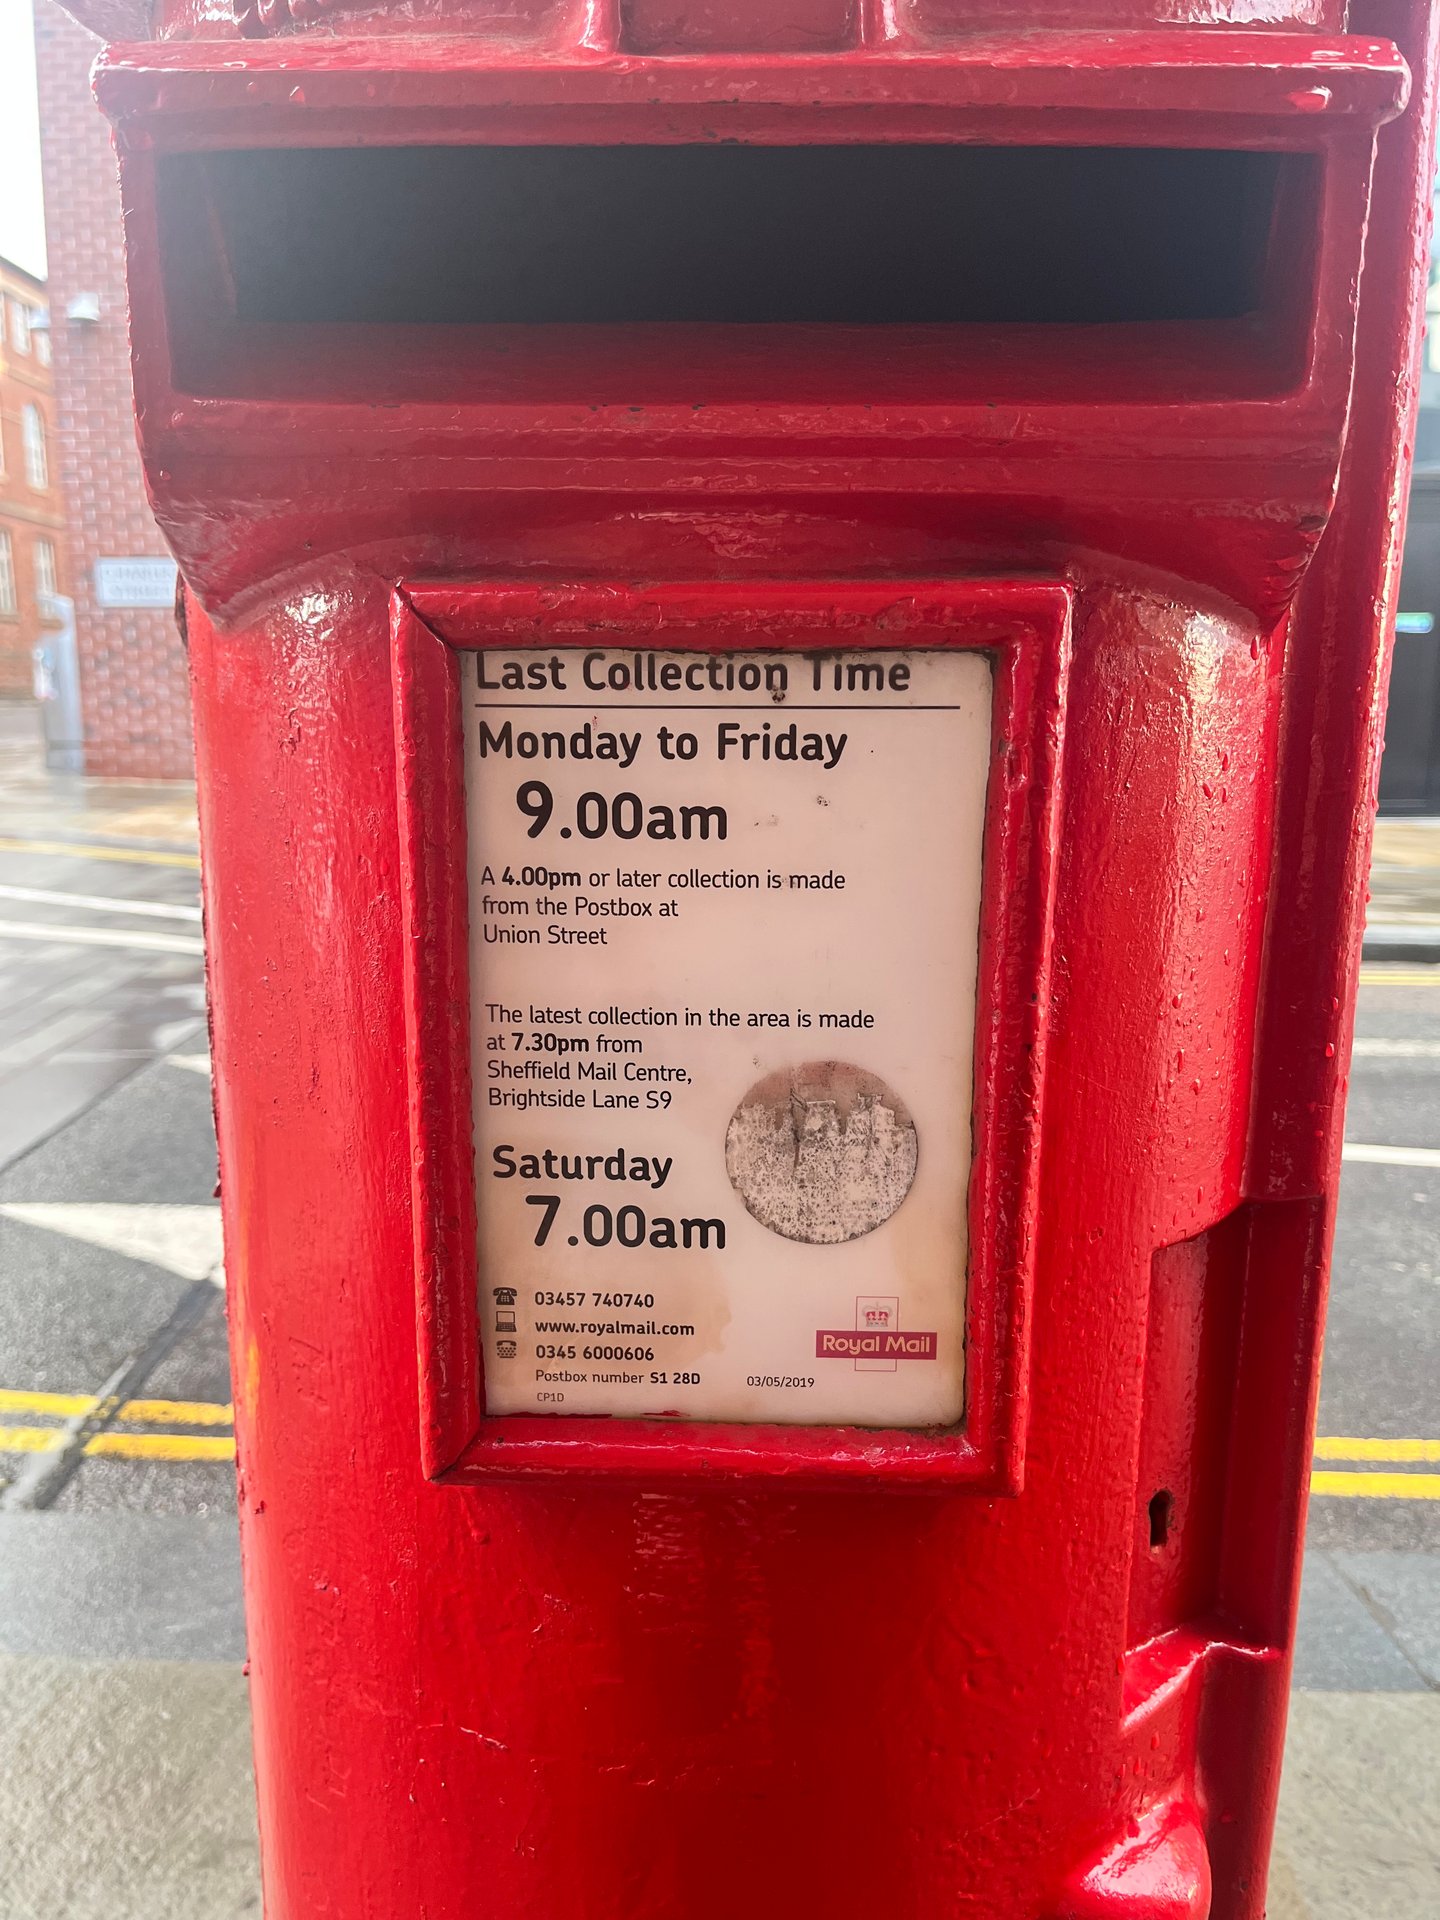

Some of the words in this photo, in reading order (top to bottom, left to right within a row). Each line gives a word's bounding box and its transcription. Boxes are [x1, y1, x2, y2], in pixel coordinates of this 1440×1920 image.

[476, 652, 566, 690] Last
[582, 653, 788, 692] Collection
[804, 655, 911, 691] Time
[479, 721, 641, 768] Monday
[657, 727, 698, 760] to
[718, 723, 847, 769] Friday
[517, 781, 727, 840] 9.00am
[481, 866, 495, 885] A
[502, 866, 581, 890] 4.00pm
[589, 873, 610, 887] or
[617, 868, 661, 887] later
[668, 869, 759, 888] collection
[768, 870, 781, 888] is
[789, 870, 845, 889] made
[482, 895, 528, 914] from
[536, 896, 567, 915] the
[576, 897, 652, 916] Postbox
[659, 900, 678, 916] at
[484, 924, 540, 943] Union
[548, 925, 607, 944] Street
[486, 1004, 522, 1023] The
[530, 1005, 582, 1024] latest
[589, 1007, 677, 1025] collection
[685, 1008, 701, 1026] in
[709, 1008, 740, 1026] the
[747, 1014, 790, 1027] area
[798, 1009, 811, 1027] is
[819, 1010, 874, 1028] made
[487, 1034, 505, 1050] at
[512, 1033, 589, 1056] 7.30pm
[596, 1034, 642, 1053] from
[488, 1060, 570, 1079] Sheffield
[578, 1062, 616, 1080] Mail
[625, 1063, 691, 1084] Centre,
[489, 1088, 585, 1110] Brightside
[593, 1090, 639, 1108] Lane
[647, 1091, 671, 1109] S9
[493, 1145, 672, 1189] Saturday
[525, 1195, 725, 1249] 7.00am
[535, 1292, 585, 1306] 03457
[592, 1293, 654, 1308] 740740
[535, 1321, 694, 1336] www.royalmail.com
[536, 1345, 576, 1359] 0345
[583, 1346, 654, 1361] 6000606
[823, 1335, 880, 1355] Royal
[885, 1336, 930, 1353] Mail
[536, 1370, 587, 1382] Postbox
[592, 1372, 644, 1383] number
[651, 1372, 667, 1383] S1
[673, 1373, 700, 1384] 28D
[747, 1376, 814, 1387] 03/05/2019
[537, 1393, 564, 1402] CP1D
